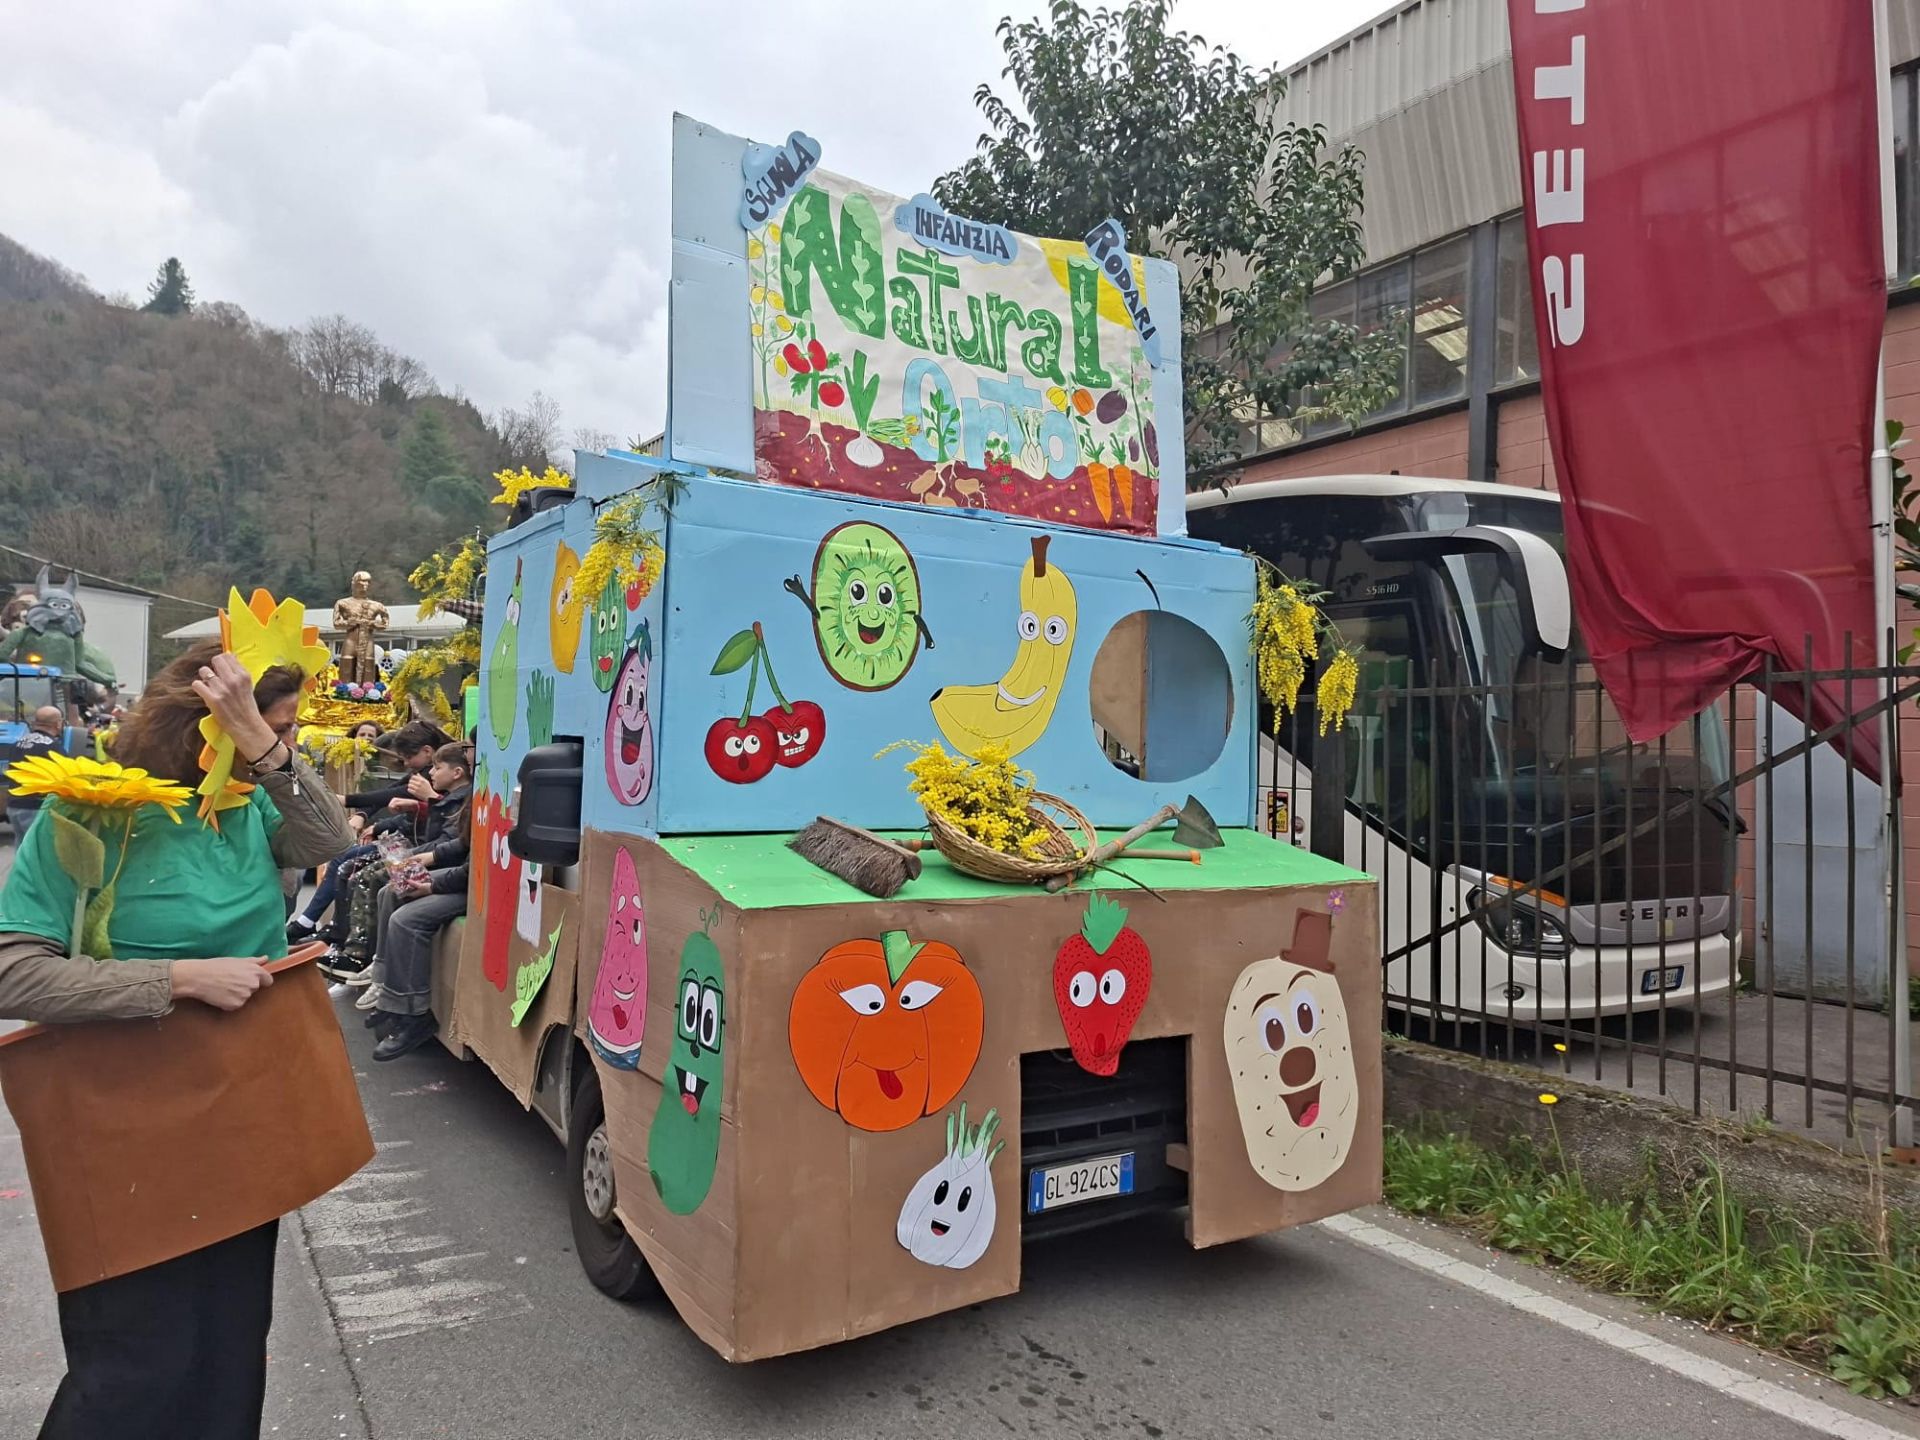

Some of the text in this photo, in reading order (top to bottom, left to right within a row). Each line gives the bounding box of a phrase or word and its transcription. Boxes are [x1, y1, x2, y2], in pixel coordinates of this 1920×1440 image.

[745, 138, 816, 222] SCUOLA
[915, 207, 1010, 259] INFANZIA
[1084, 222, 1157, 341] RODARI
[902, 358, 1078, 480] Orto
[1046, 1175, 1064, 1200] GL
[1070, 1164, 1119, 1195] 924CS
